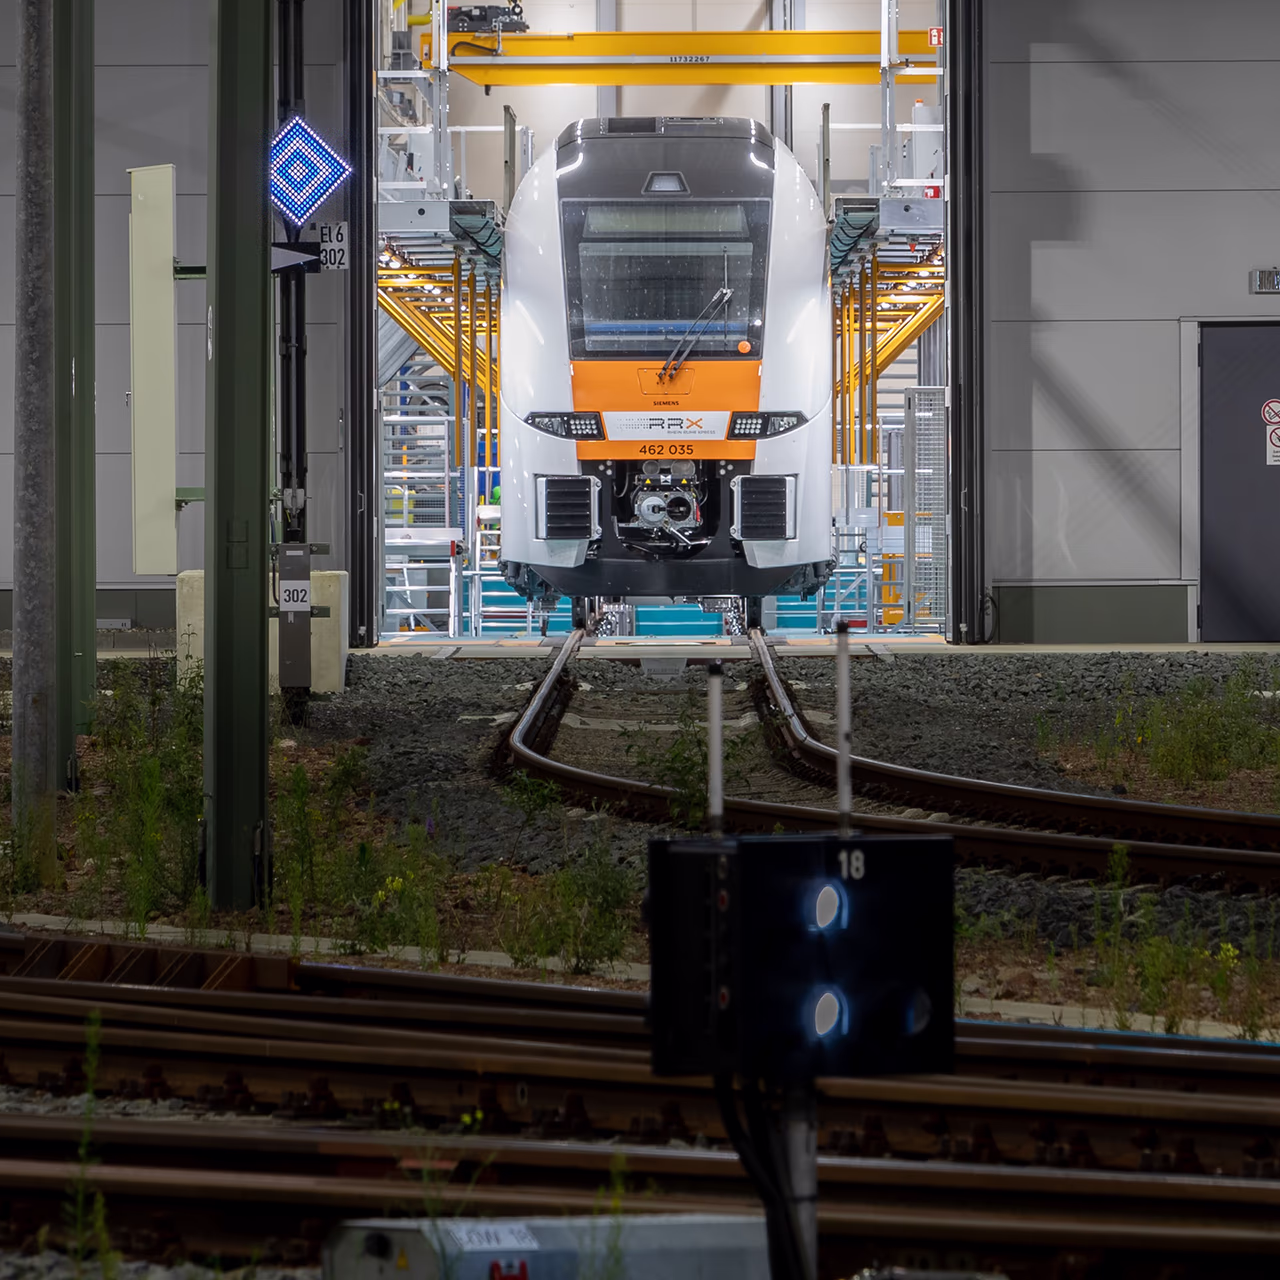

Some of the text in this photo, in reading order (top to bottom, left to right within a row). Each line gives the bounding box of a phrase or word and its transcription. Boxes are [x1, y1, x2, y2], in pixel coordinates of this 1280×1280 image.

[336, 225, 344, 243] 6
[320, 248, 346, 266] 302
[648, 417, 703, 429] RRX
[639, 444, 694, 455] 462 035
[283, 588, 308, 603] 302
[838, 849, 866, 880] 18
